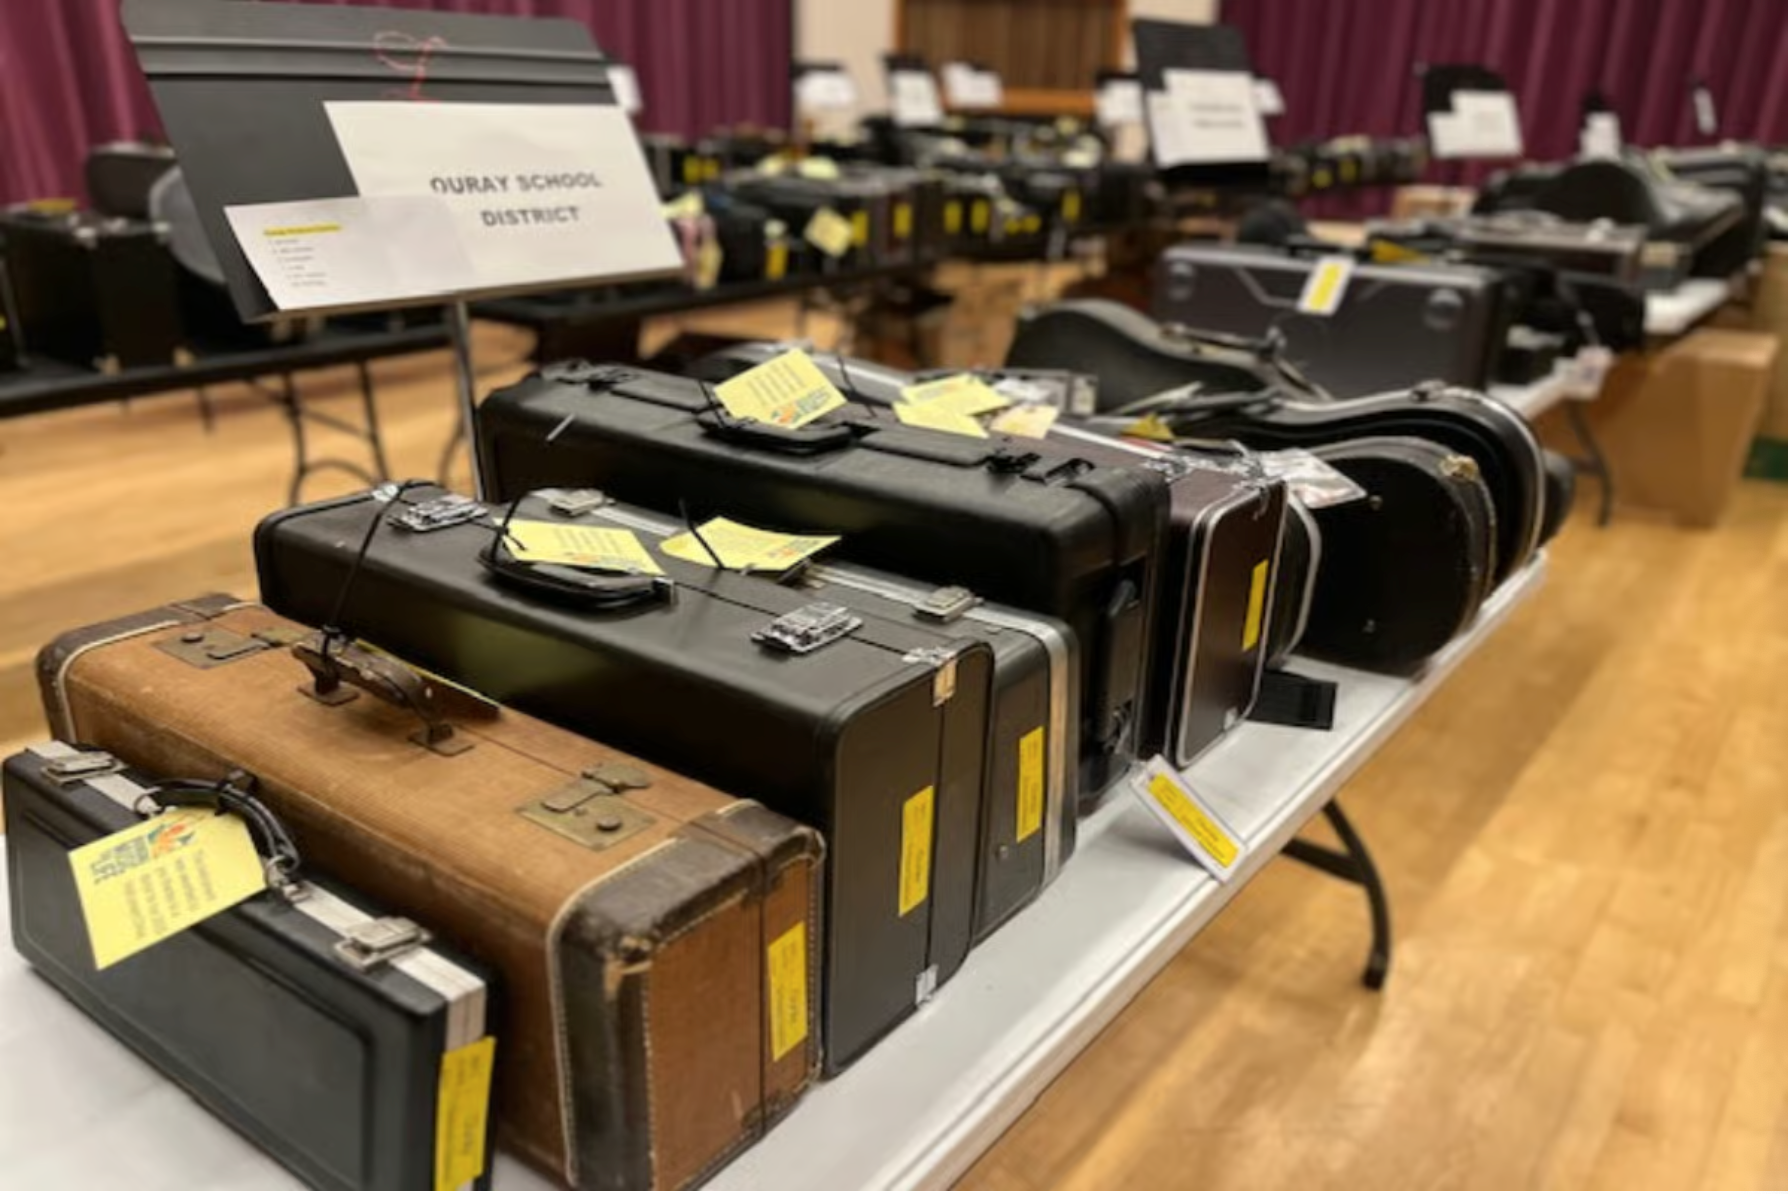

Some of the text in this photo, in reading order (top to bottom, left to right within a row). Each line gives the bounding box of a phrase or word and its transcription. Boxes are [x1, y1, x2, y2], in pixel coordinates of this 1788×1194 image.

[430, 172, 602, 194] OURAY SCHOOL
[481, 206, 579, 226] DISTRICT
